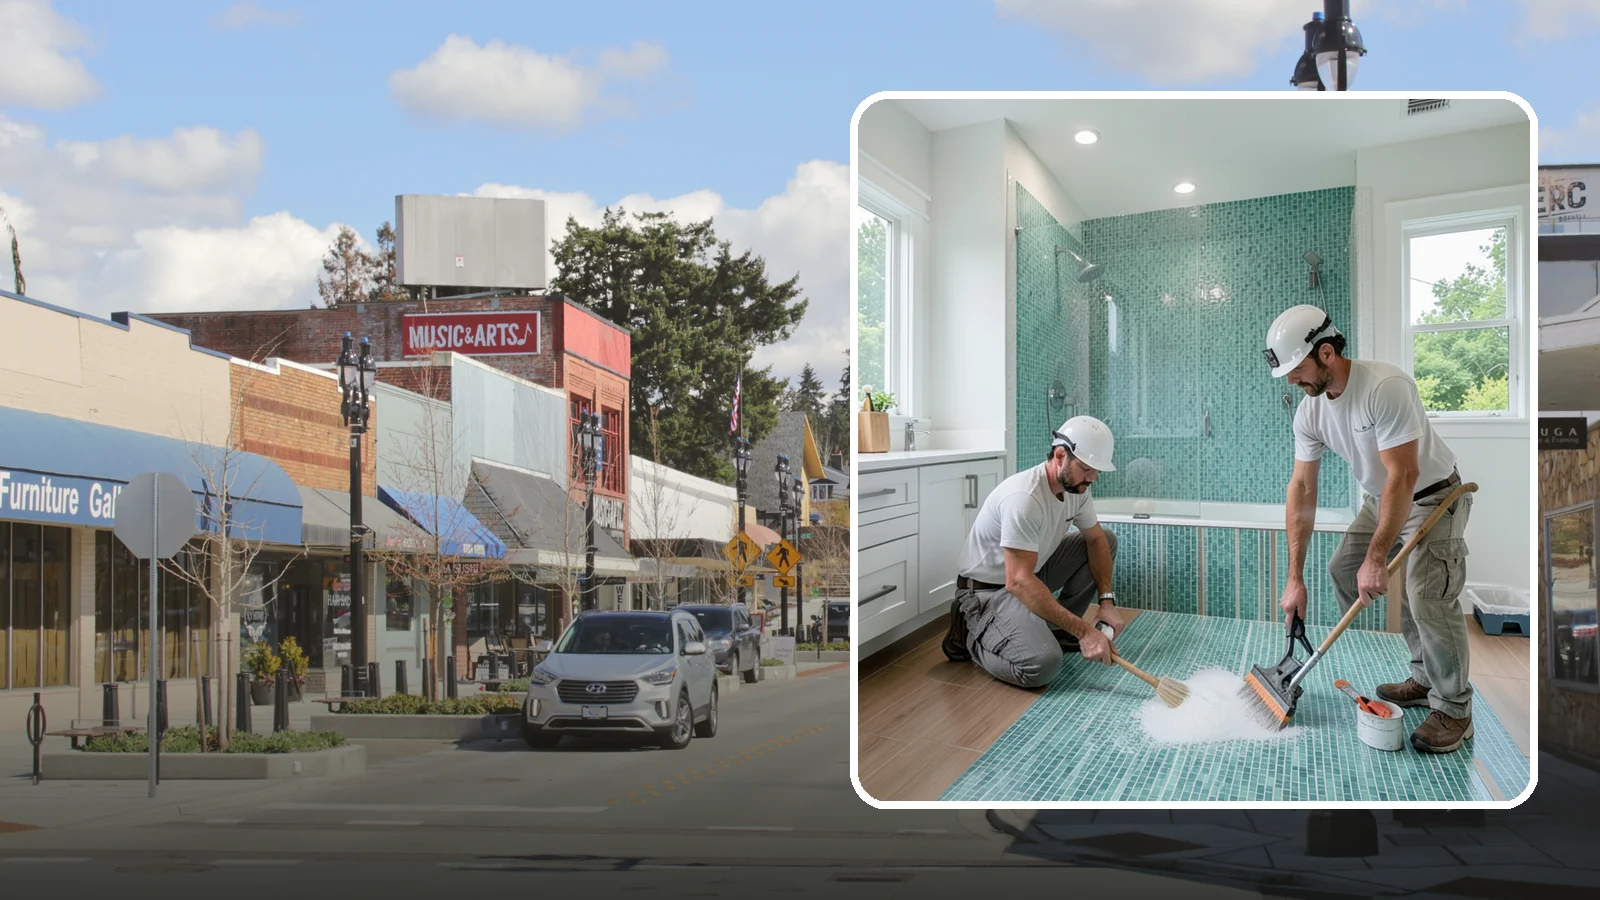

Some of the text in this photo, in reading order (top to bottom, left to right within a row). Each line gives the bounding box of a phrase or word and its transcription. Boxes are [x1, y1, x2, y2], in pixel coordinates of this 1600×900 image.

[409, 323, 519, 349] MUSIC&ARTS
[0, 472, 122, 519] Furniture Gal
[453, 563, 480, 575] SUSHI
